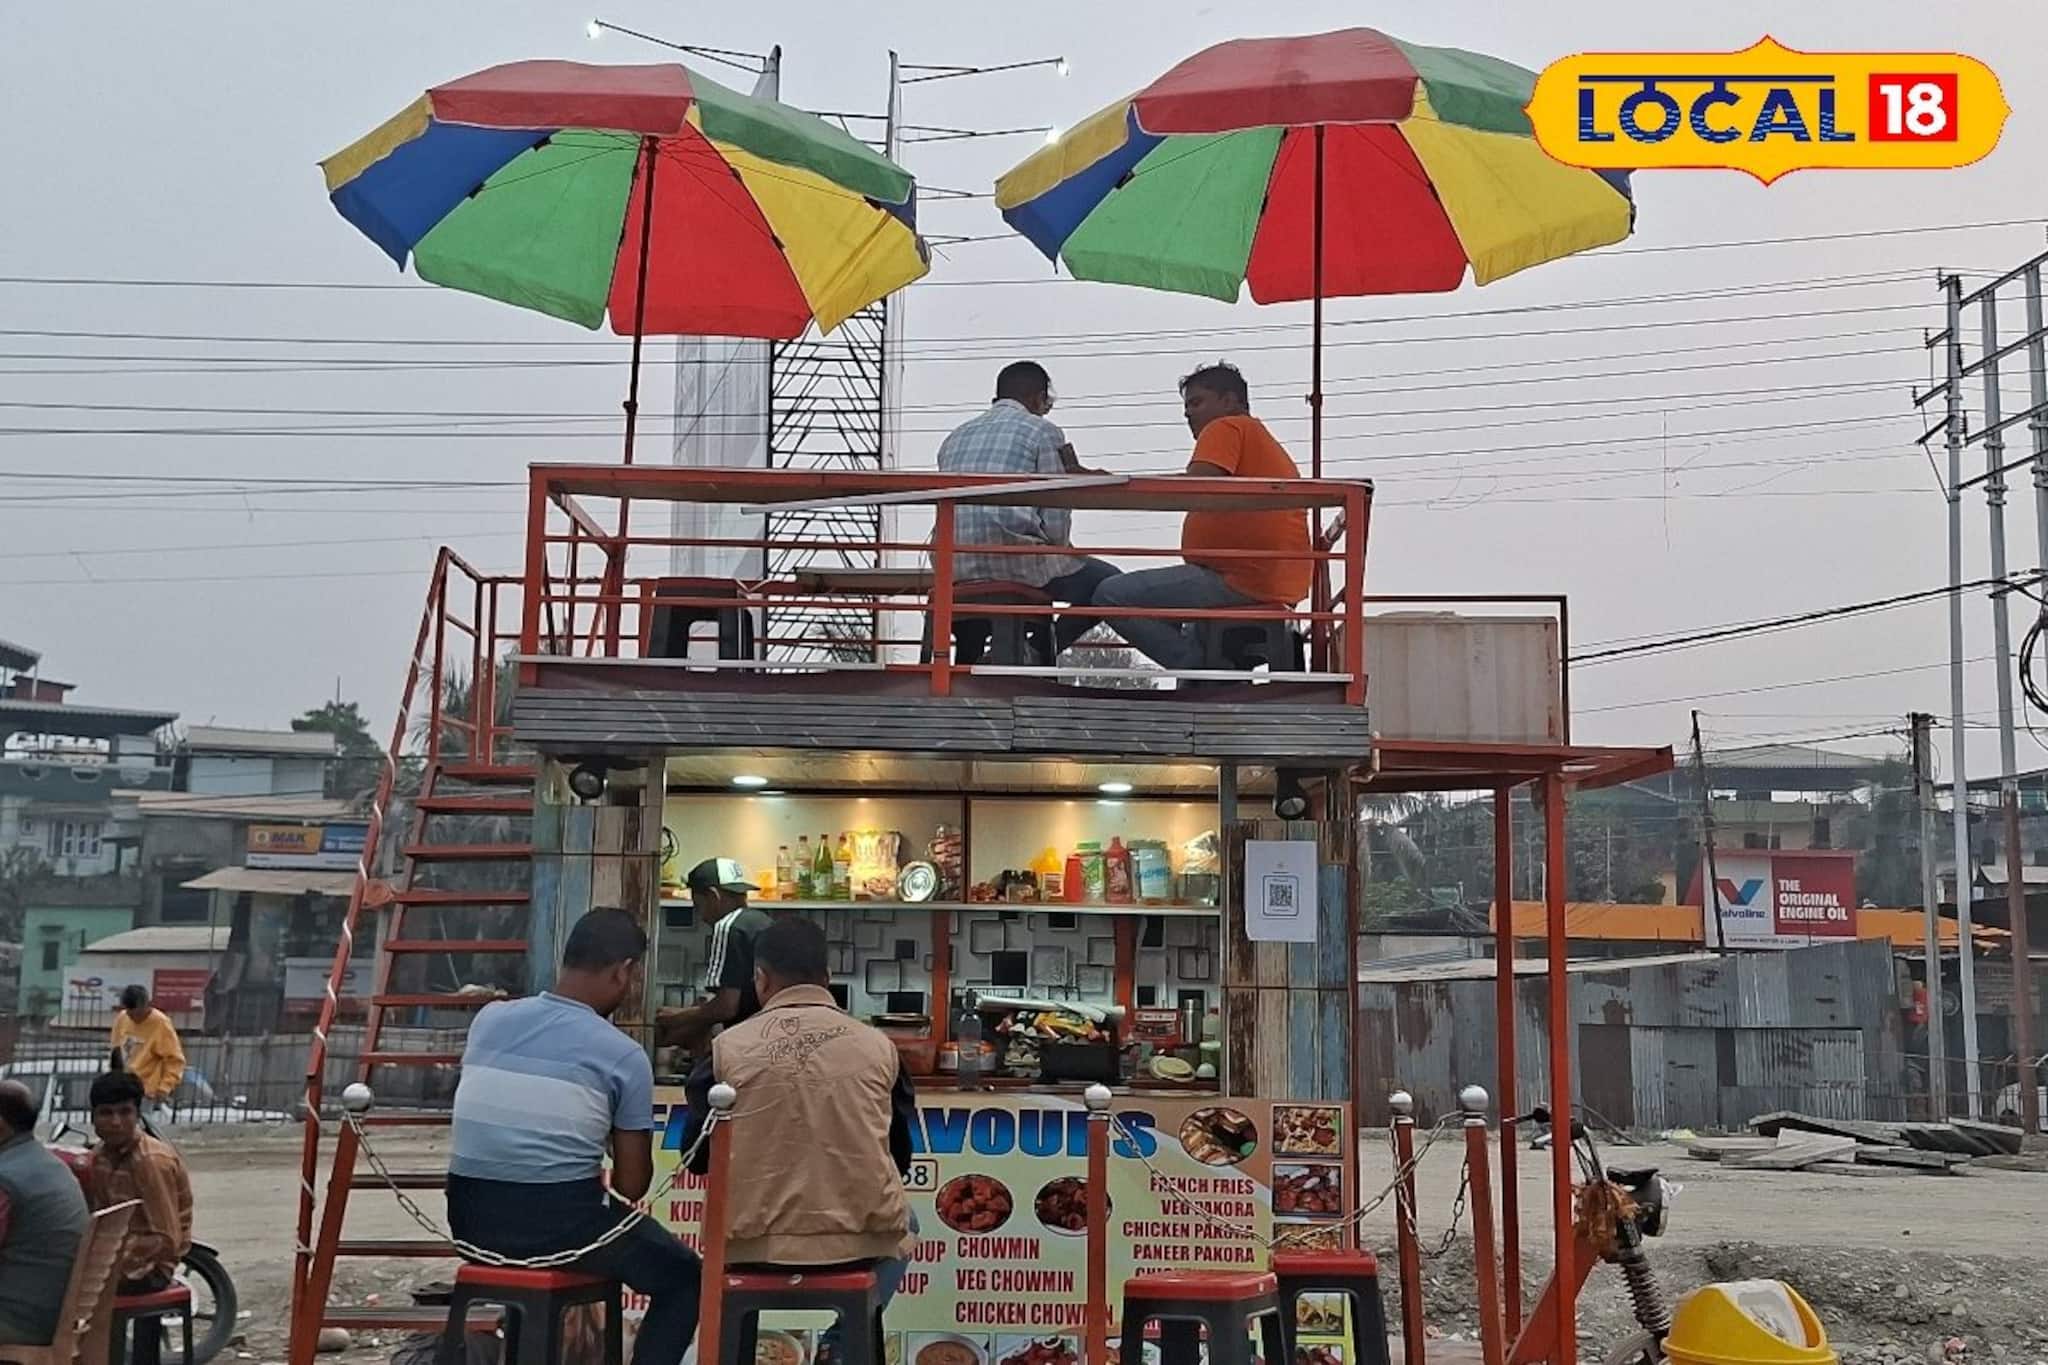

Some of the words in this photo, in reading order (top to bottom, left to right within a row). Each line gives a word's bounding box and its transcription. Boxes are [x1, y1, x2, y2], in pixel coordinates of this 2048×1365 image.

[1779, 879, 1800, 891] THE
[1779, 893, 1840, 907] ORIGINAL
[1719, 908, 1766, 919] alvoline
[1779, 907, 1825, 920] ENGINE
[1827, 907, 1848, 921] OIL
[1213, 1178, 1255, 1195] FRIES
[1122, 1221, 1190, 1238] CHICKEN
[908, 1240, 946, 1263] OUP
[957, 1236, 1040, 1260] CHOWMIN
[1133, 1244, 1190, 1260] PANEER
[1194, 1246, 1255, 1263] PAKORA
[896, 1272, 929, 1294] OUP
[956, 1268, 986, 1291] VEG
[991, 1270, 1074, 1293] CHOWMIN
[955, 1301, 1026, 1325] CHICKEN
[1031, 1303, 1113, 1326] CHOWN
